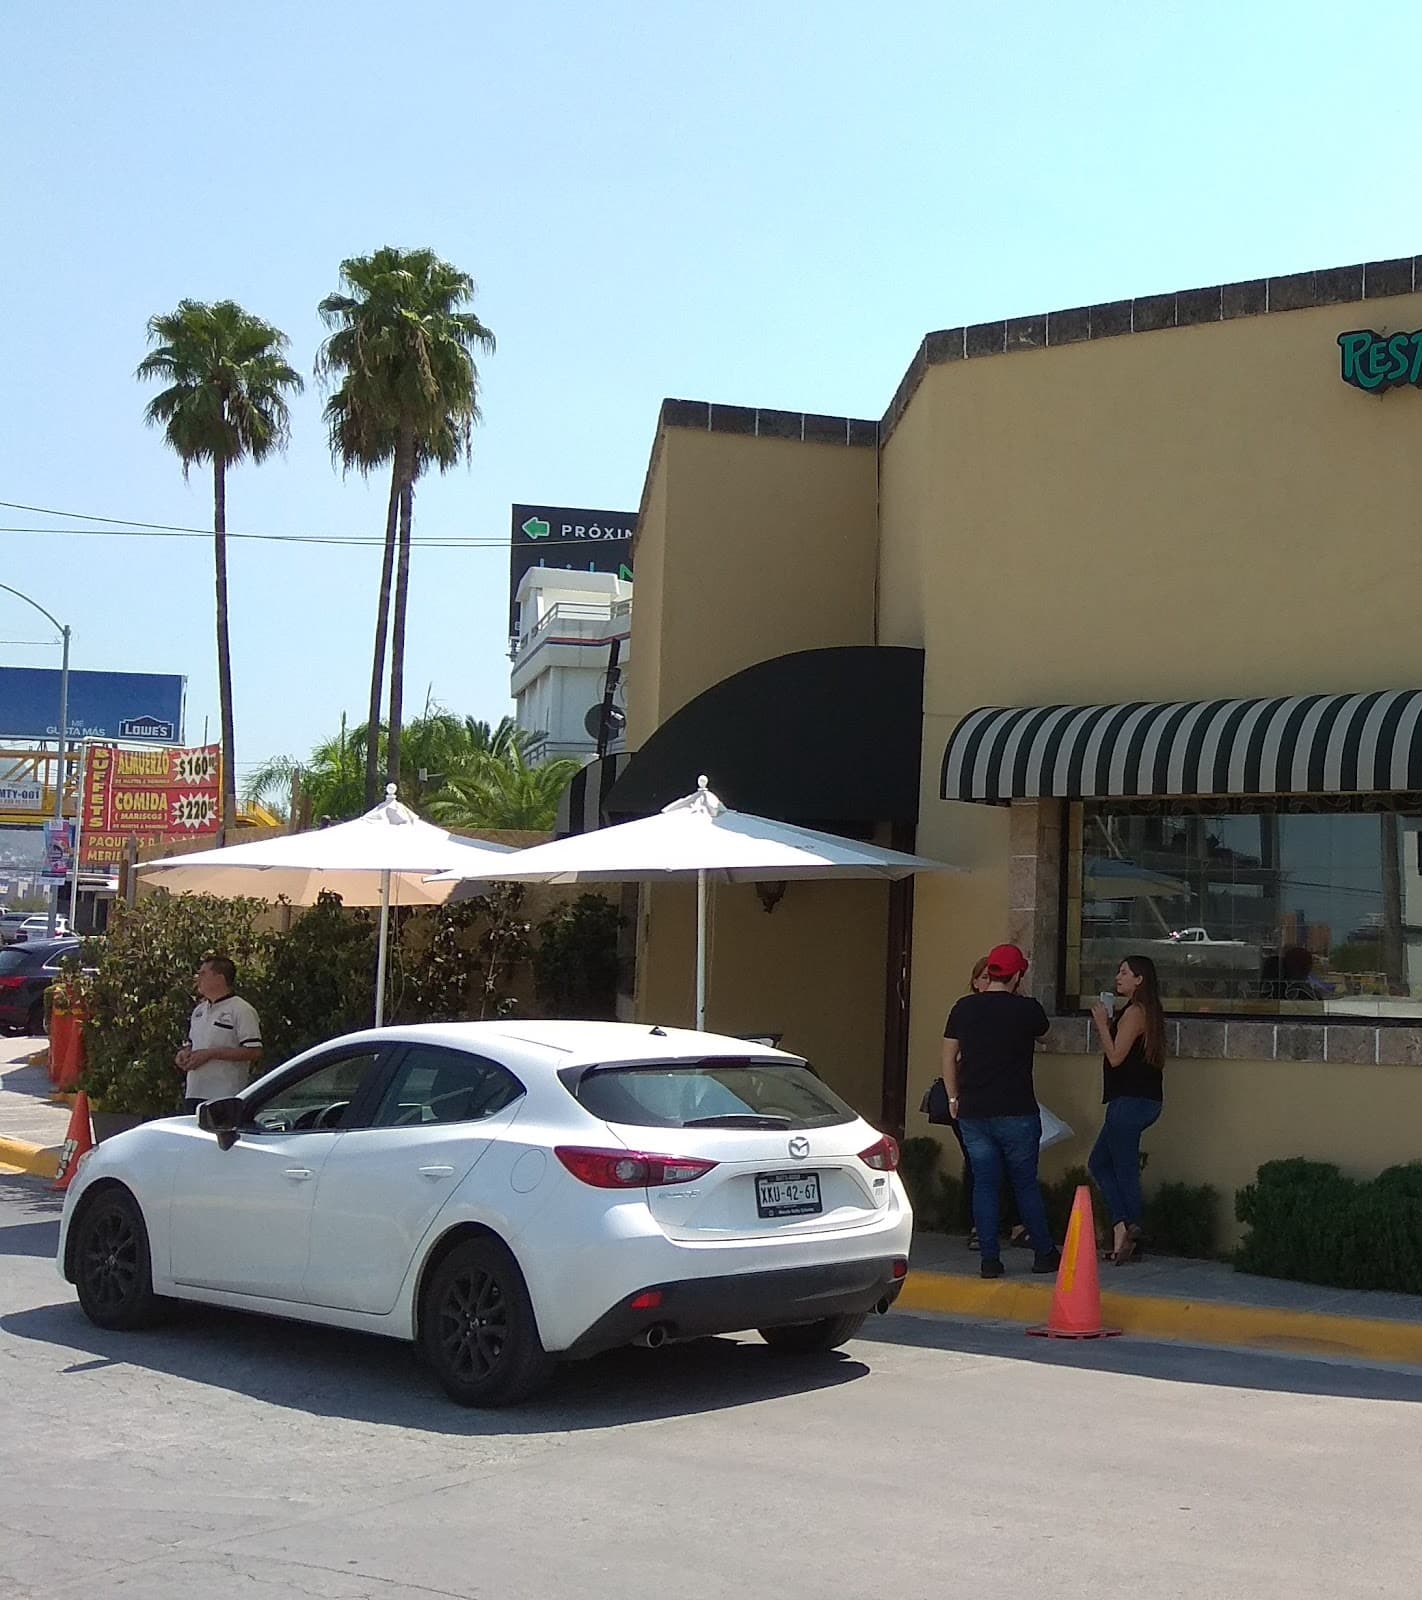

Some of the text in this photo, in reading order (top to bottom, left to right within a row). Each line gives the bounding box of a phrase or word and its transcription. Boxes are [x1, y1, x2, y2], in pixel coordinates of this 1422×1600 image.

[46, 726, 106, 737] GUTA MÁS
[124, 723, 168, 737] LOWE'S
[117, 750, 170, 775] ALMUERZO
[114, 791, 168, 811] COMIDA
[178, 800, 208, 821] $220
